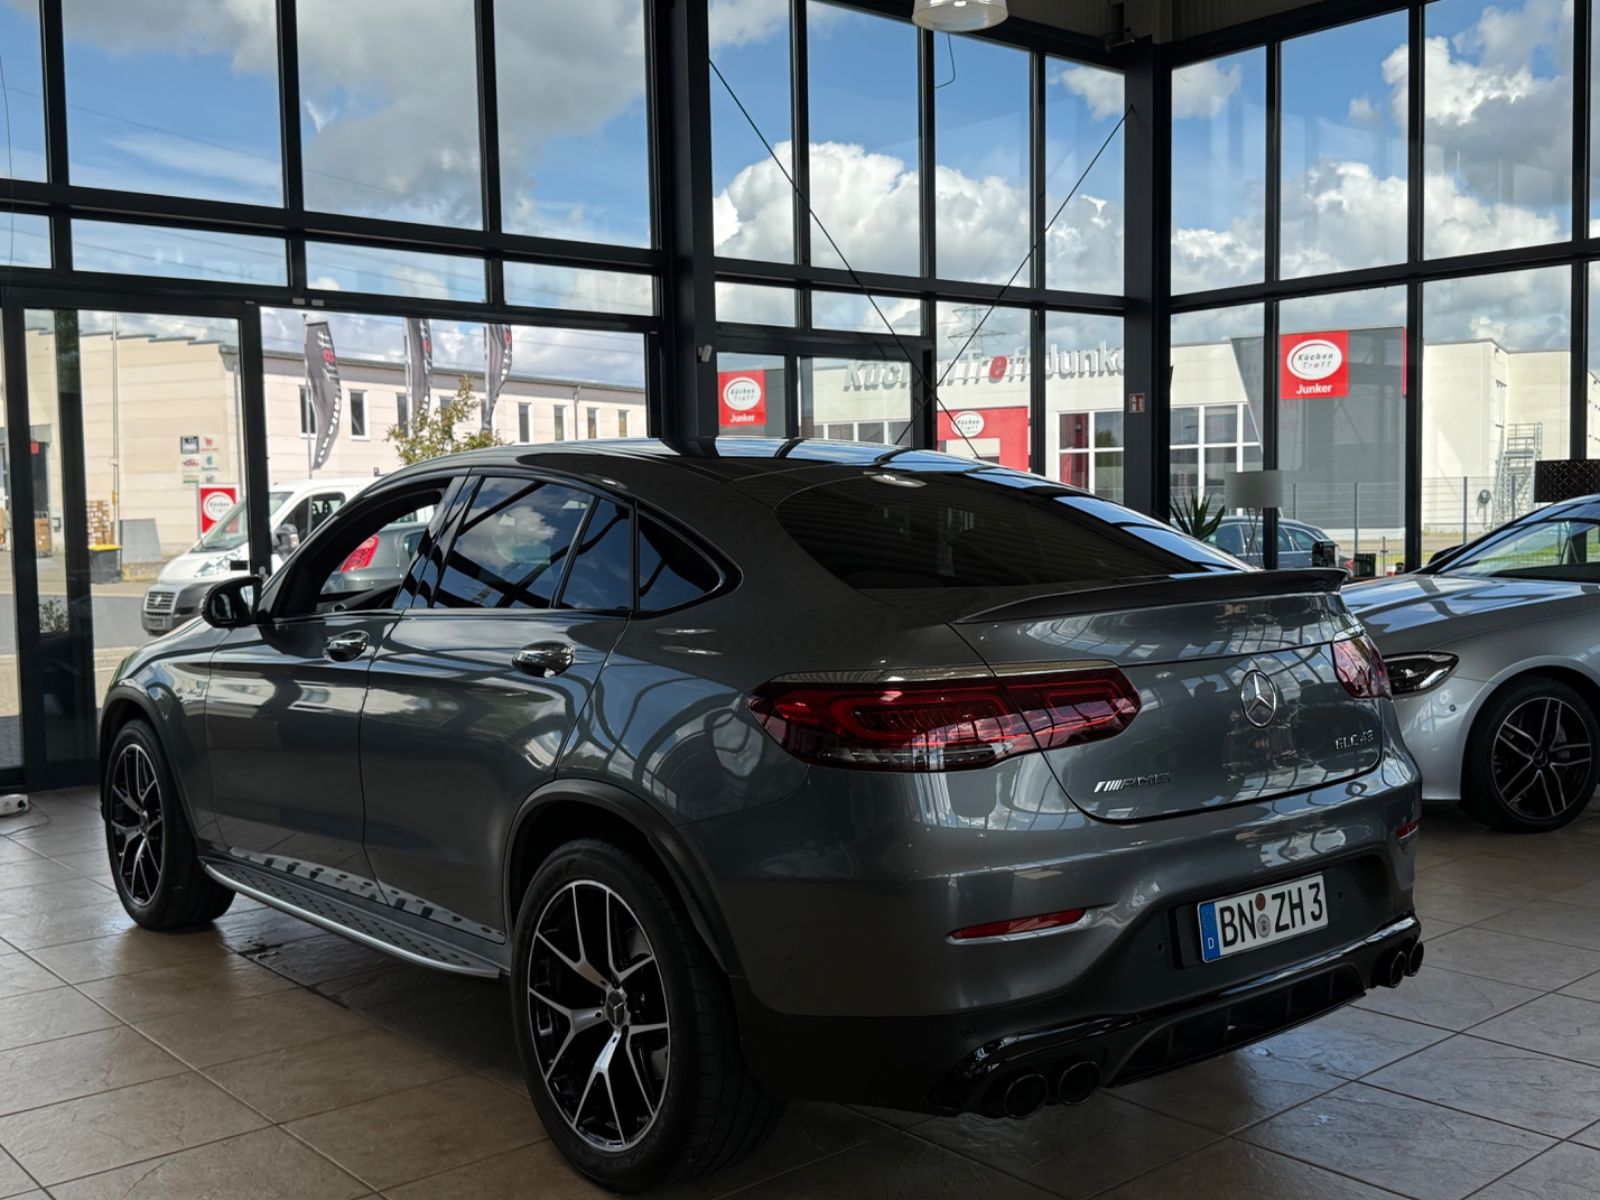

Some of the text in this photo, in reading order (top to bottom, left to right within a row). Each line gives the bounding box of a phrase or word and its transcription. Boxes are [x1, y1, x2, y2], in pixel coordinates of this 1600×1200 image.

[1298, 352, 1333, 361] Küchen
[1303, 361, 1331, 369] Treff
[1296, 383, 1333, 395] Junker
[1335, 734, 1359, 750] GLC
[1219, 882, 1323, 947] BN ZH 3
[1207, 937, 1215, 949] D
